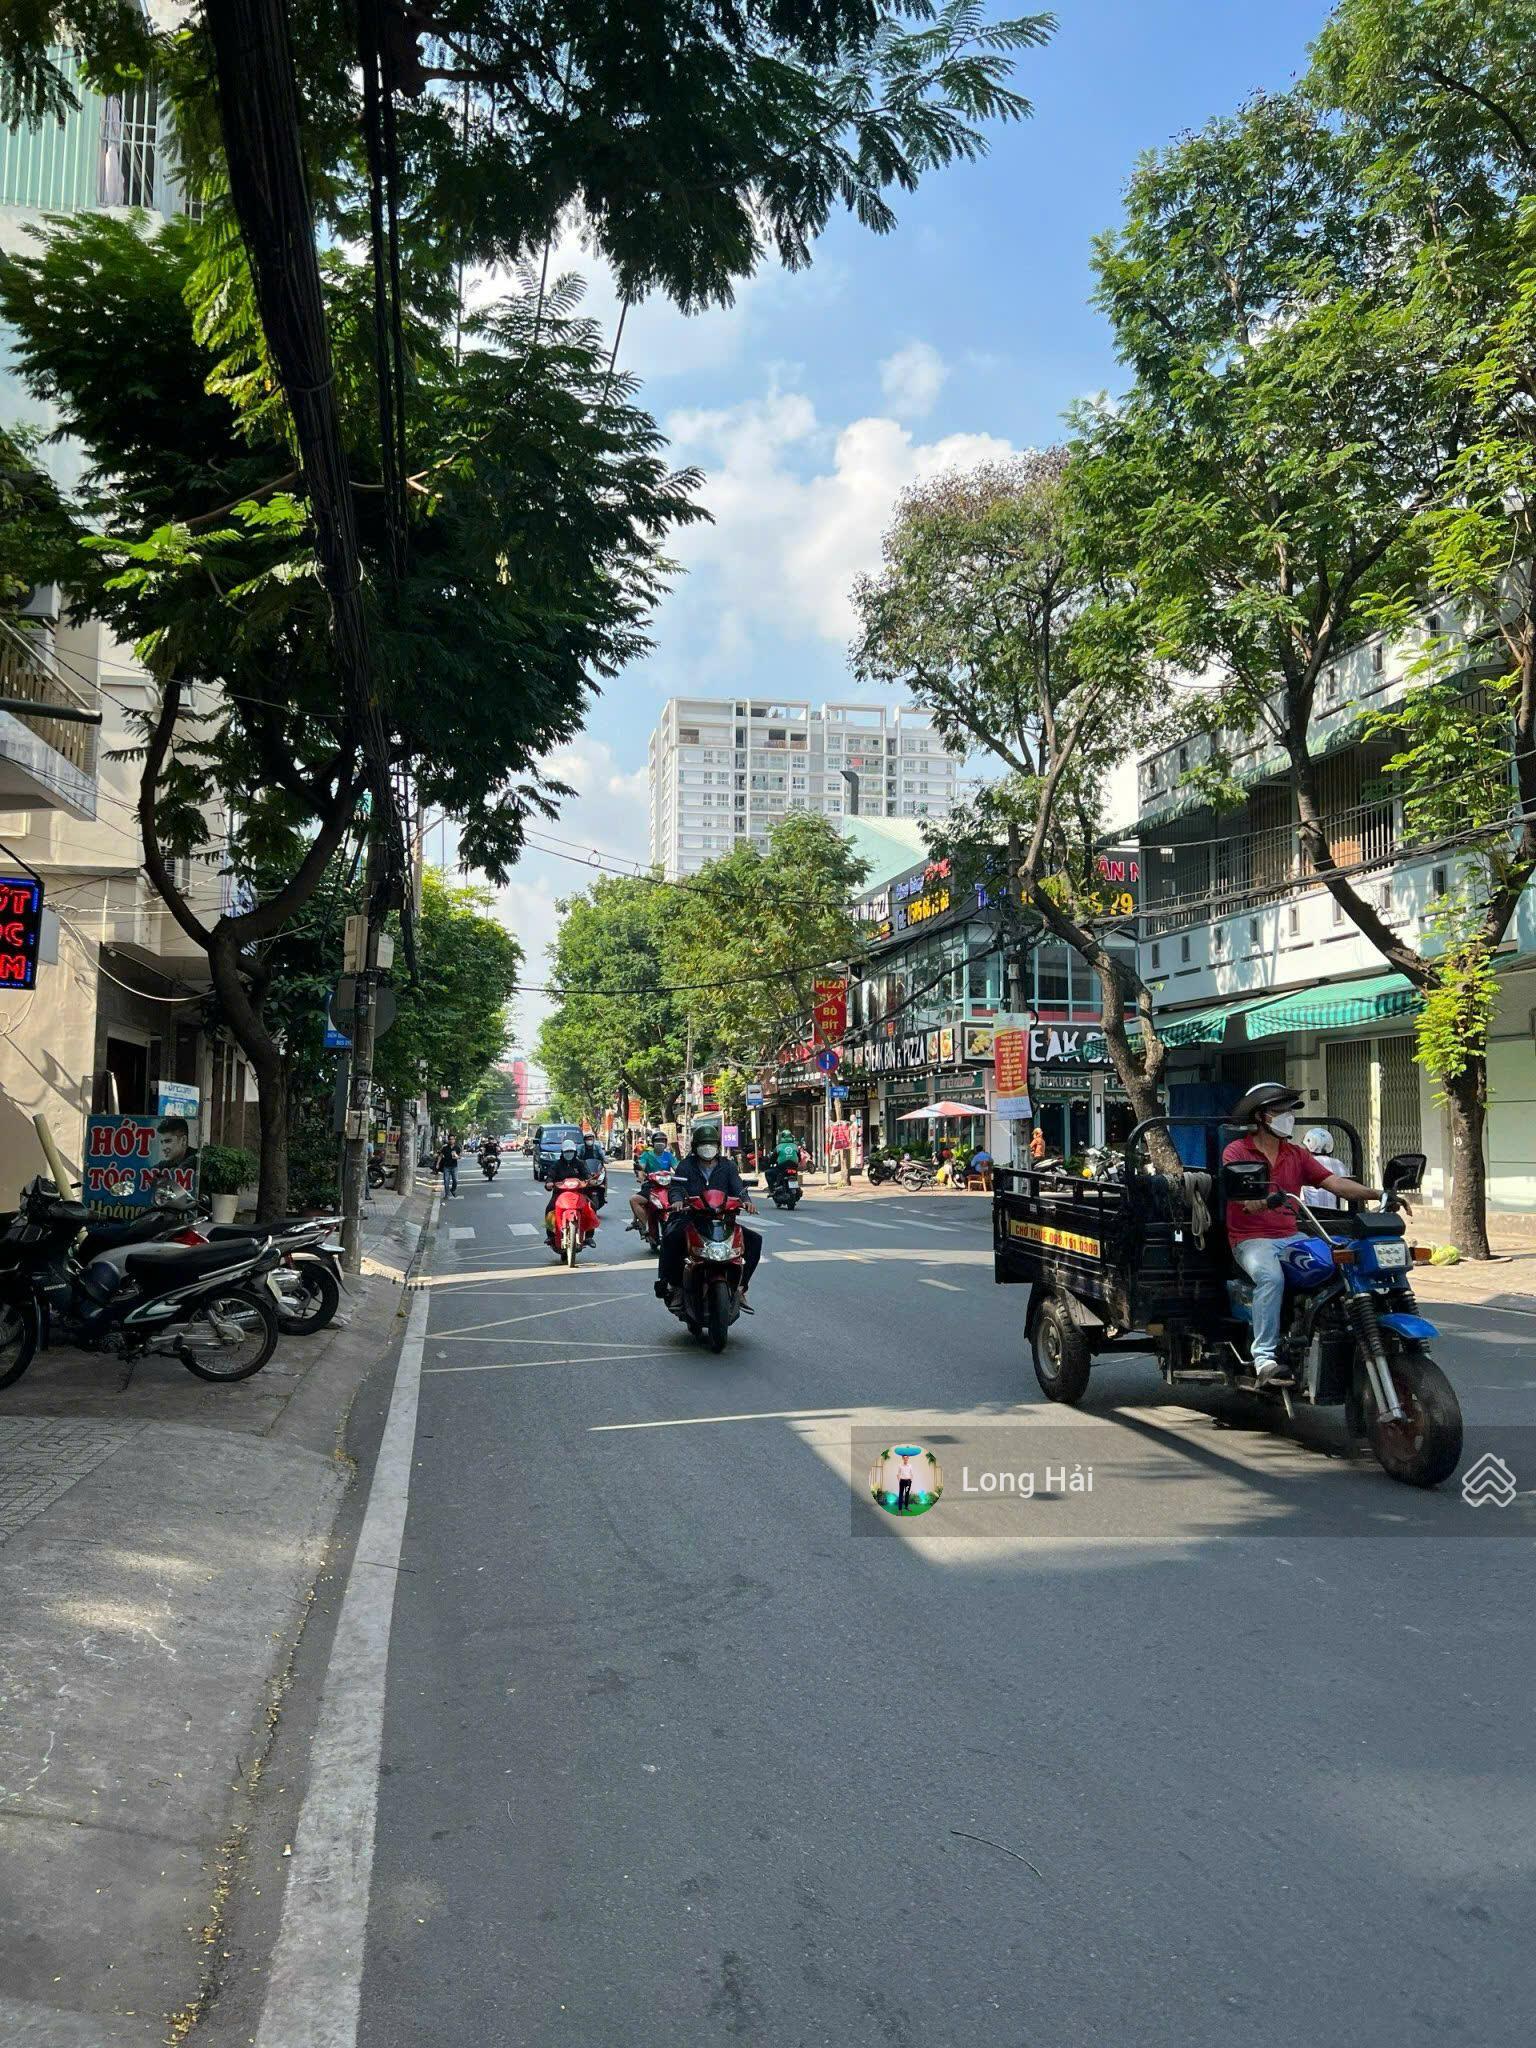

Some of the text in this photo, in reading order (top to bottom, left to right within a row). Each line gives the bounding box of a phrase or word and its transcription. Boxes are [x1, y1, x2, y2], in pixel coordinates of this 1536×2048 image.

[815, 980, 845, 989] PIZZA
[821, 1019, 839, 1030] BÍT
[822, 1005, 838, 1016] BÒ
[903, 1034, 926, 1067] PIZZA
[1029, 1029, 1081, 1063] EAK
[90, 1118, 156, 1157] HỚT
[88, 1162, 136, 1193] TÓC
